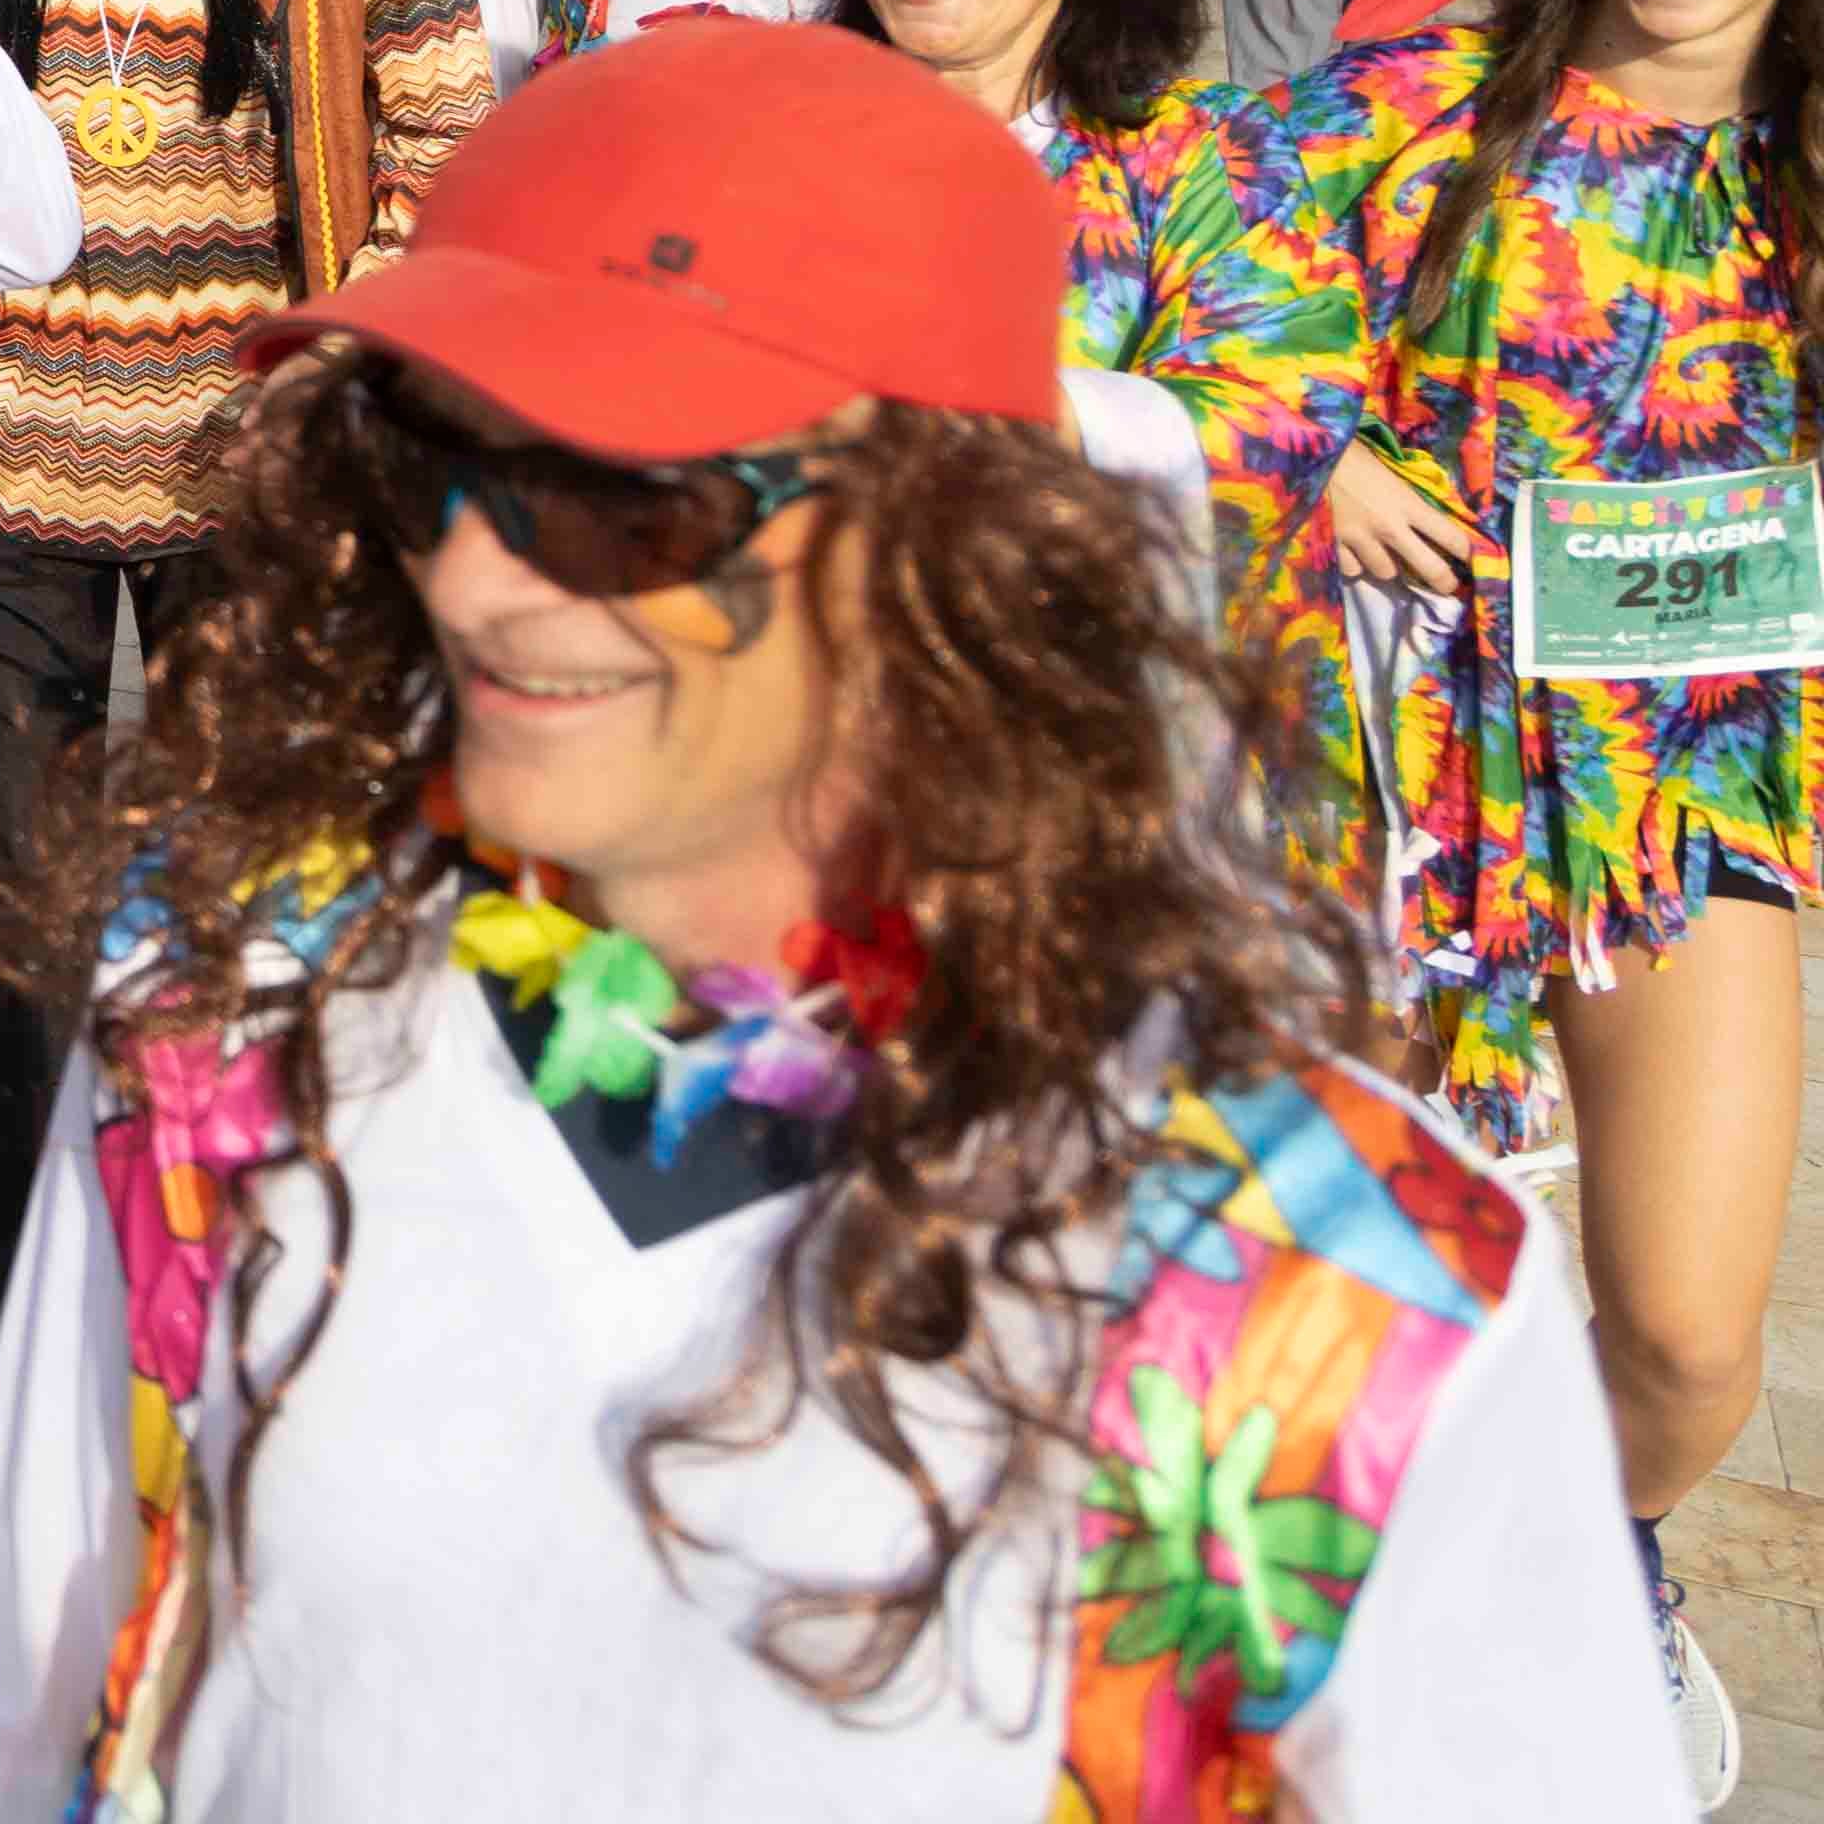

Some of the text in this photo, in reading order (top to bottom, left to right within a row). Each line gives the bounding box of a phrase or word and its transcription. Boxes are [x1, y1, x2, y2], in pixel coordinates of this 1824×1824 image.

[1546, 497, 1623, 526] SAN
[1565, 517, 1787, 558] CARTAGENA
[1615, 551, 1740, 608] 291
